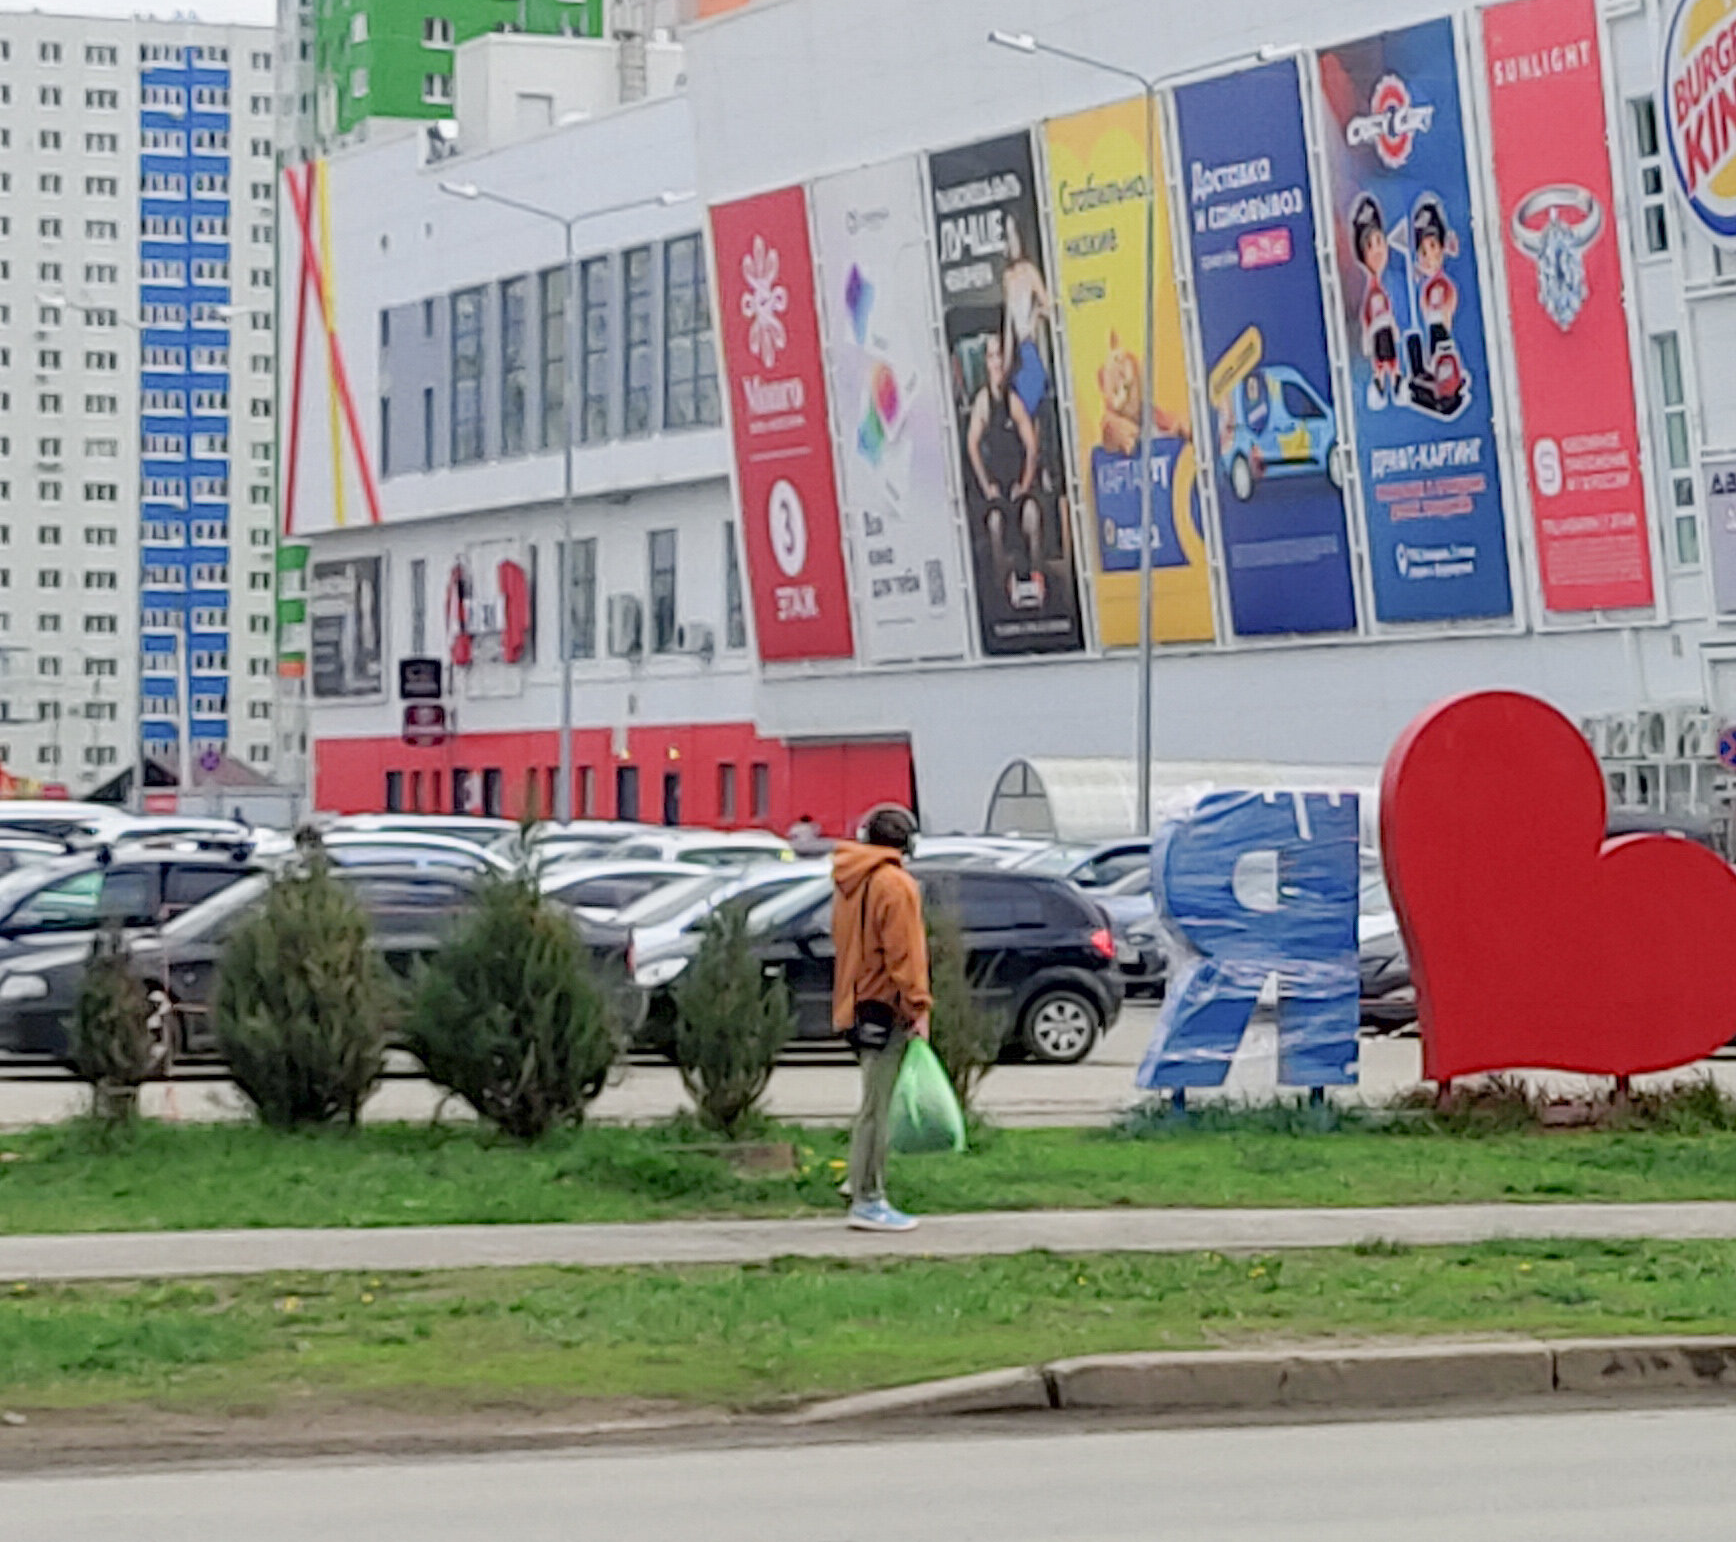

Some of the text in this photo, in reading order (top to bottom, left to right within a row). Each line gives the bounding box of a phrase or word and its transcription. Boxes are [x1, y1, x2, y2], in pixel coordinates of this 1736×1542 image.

[1493, 39, 1591, 87] SUNLIGHT
[1191, 157, 1271, 204] Доставка
[1137, 789, 1361, 1088] Я
